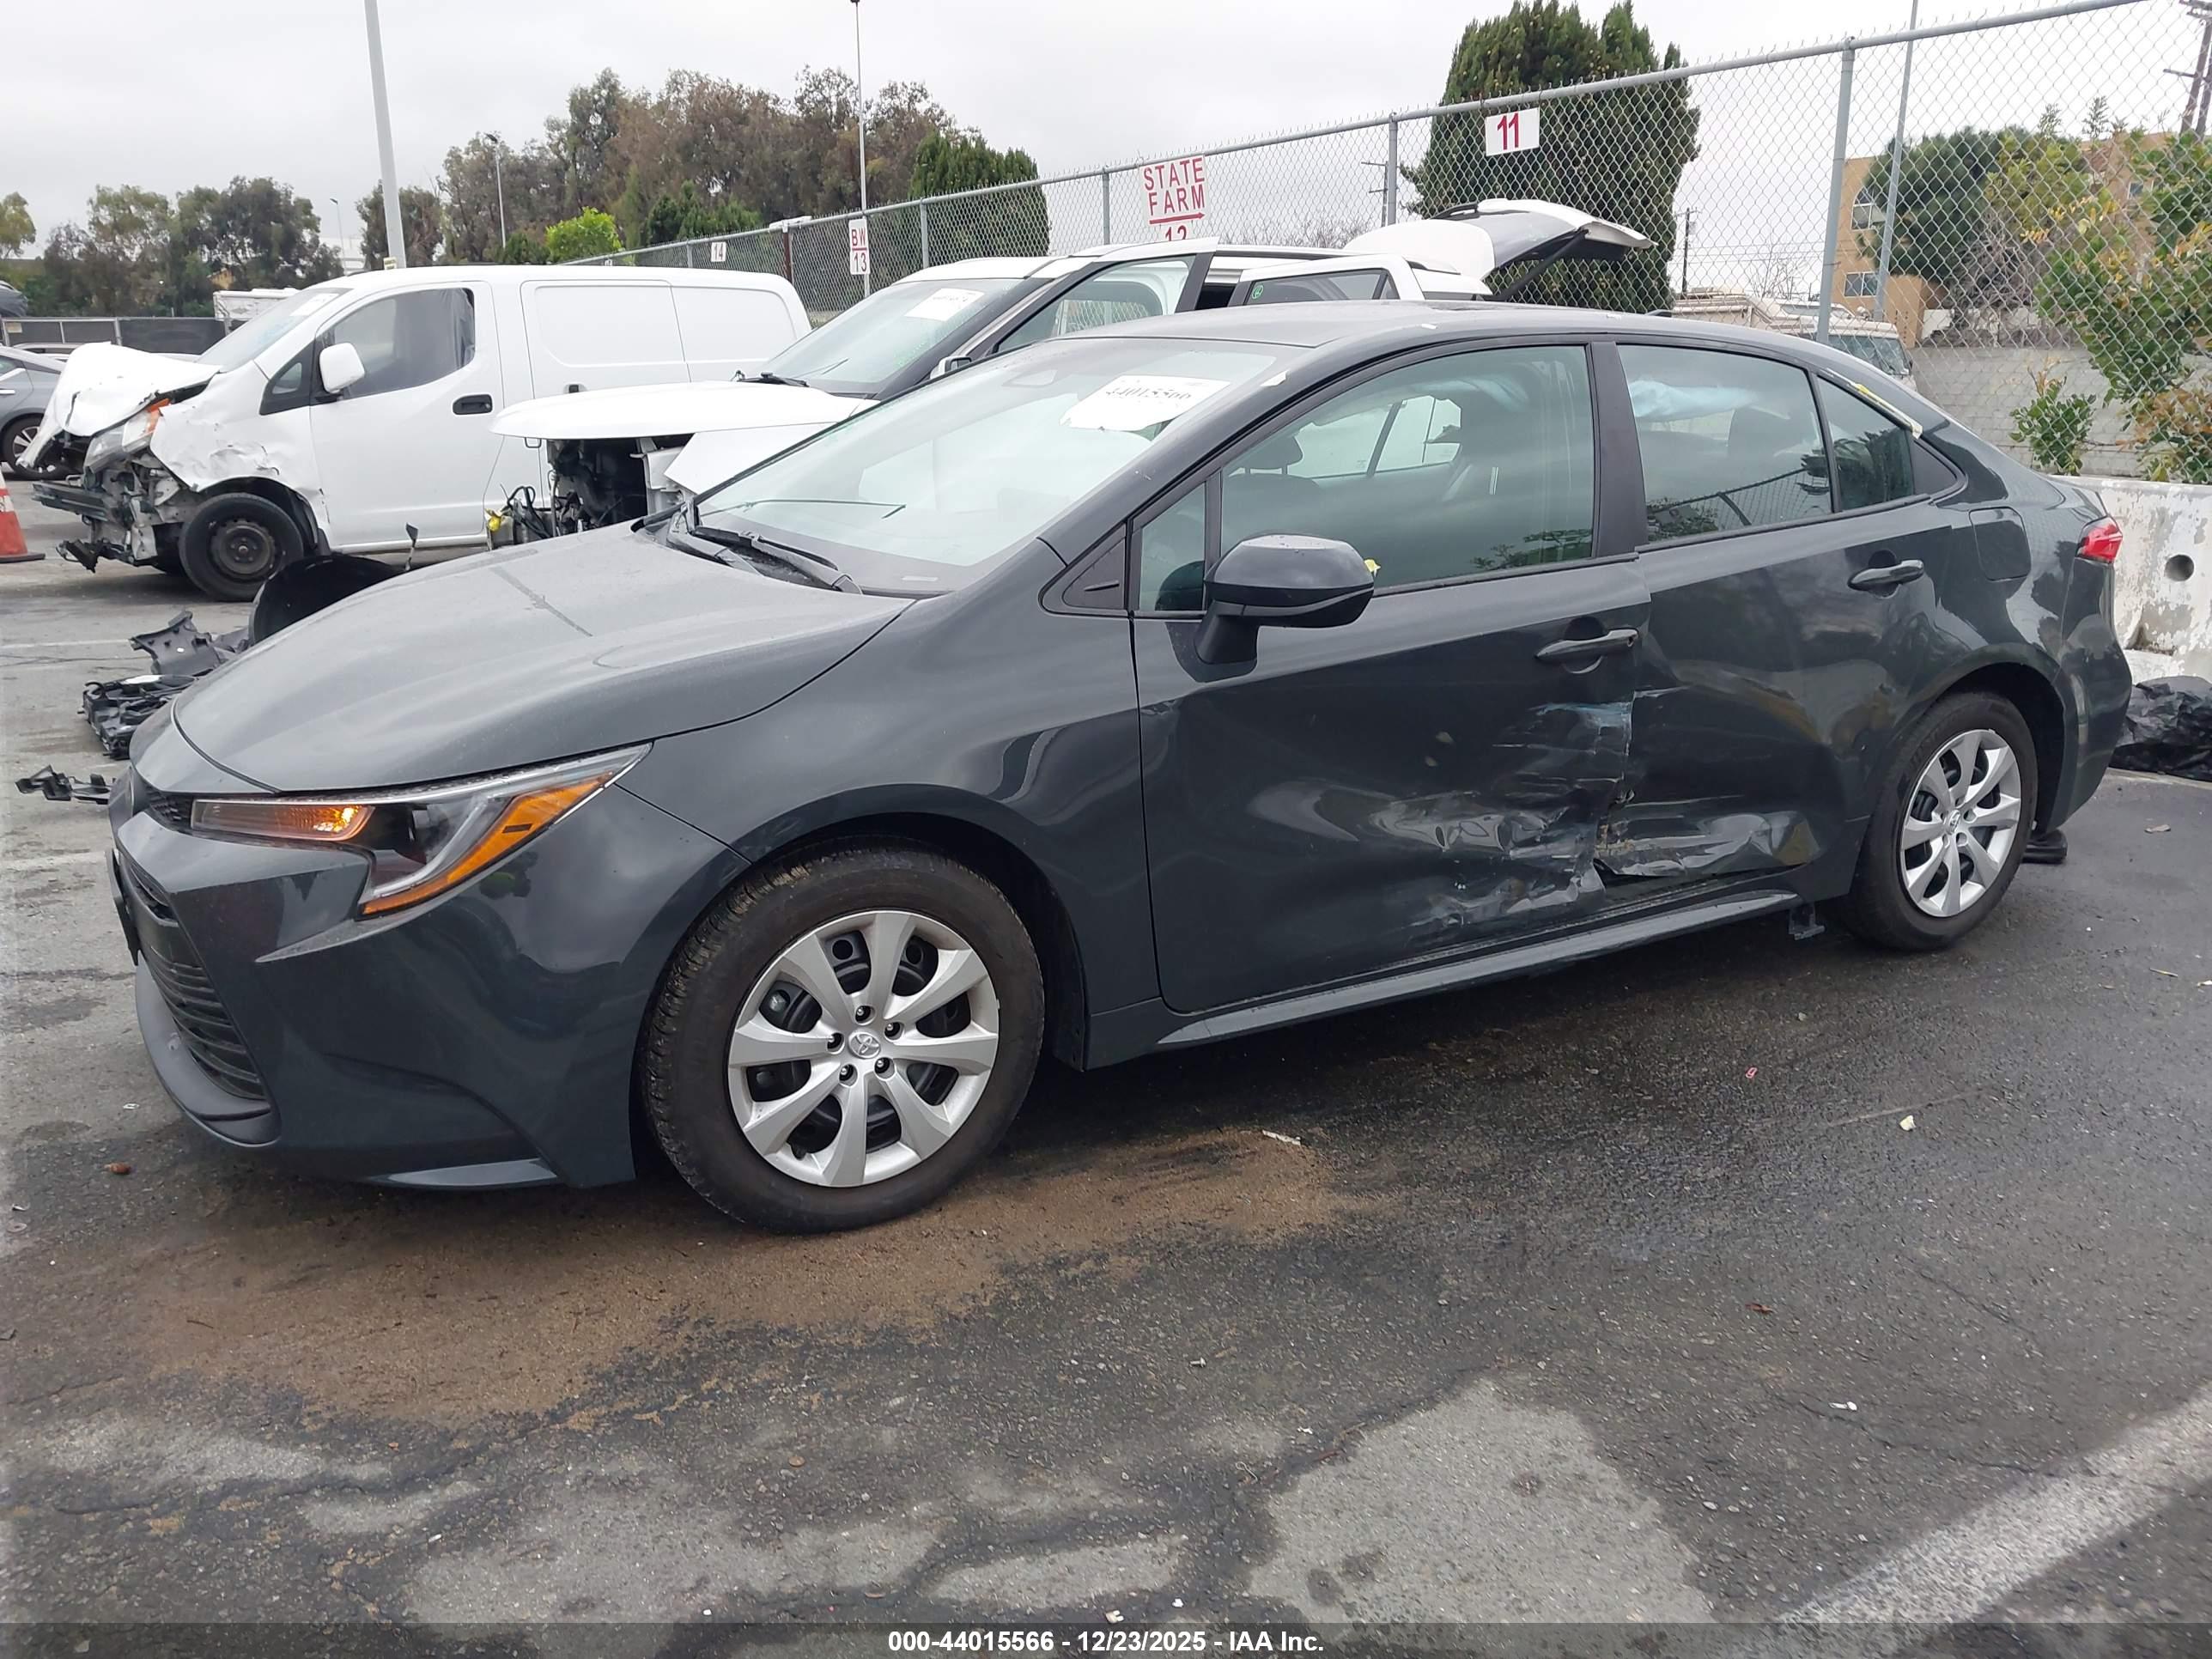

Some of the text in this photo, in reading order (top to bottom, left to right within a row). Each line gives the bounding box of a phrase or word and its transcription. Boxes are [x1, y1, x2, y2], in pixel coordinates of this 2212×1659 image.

[1497, 112, 1519, 151] 11
[1143, 157, 1206, 191] STATE
[1147, 184, 1206, 216] FARM
[851, 227, 866, 246] BW
[714, 242, 724, 261] 14
[854, 252, 867, 273] 13
